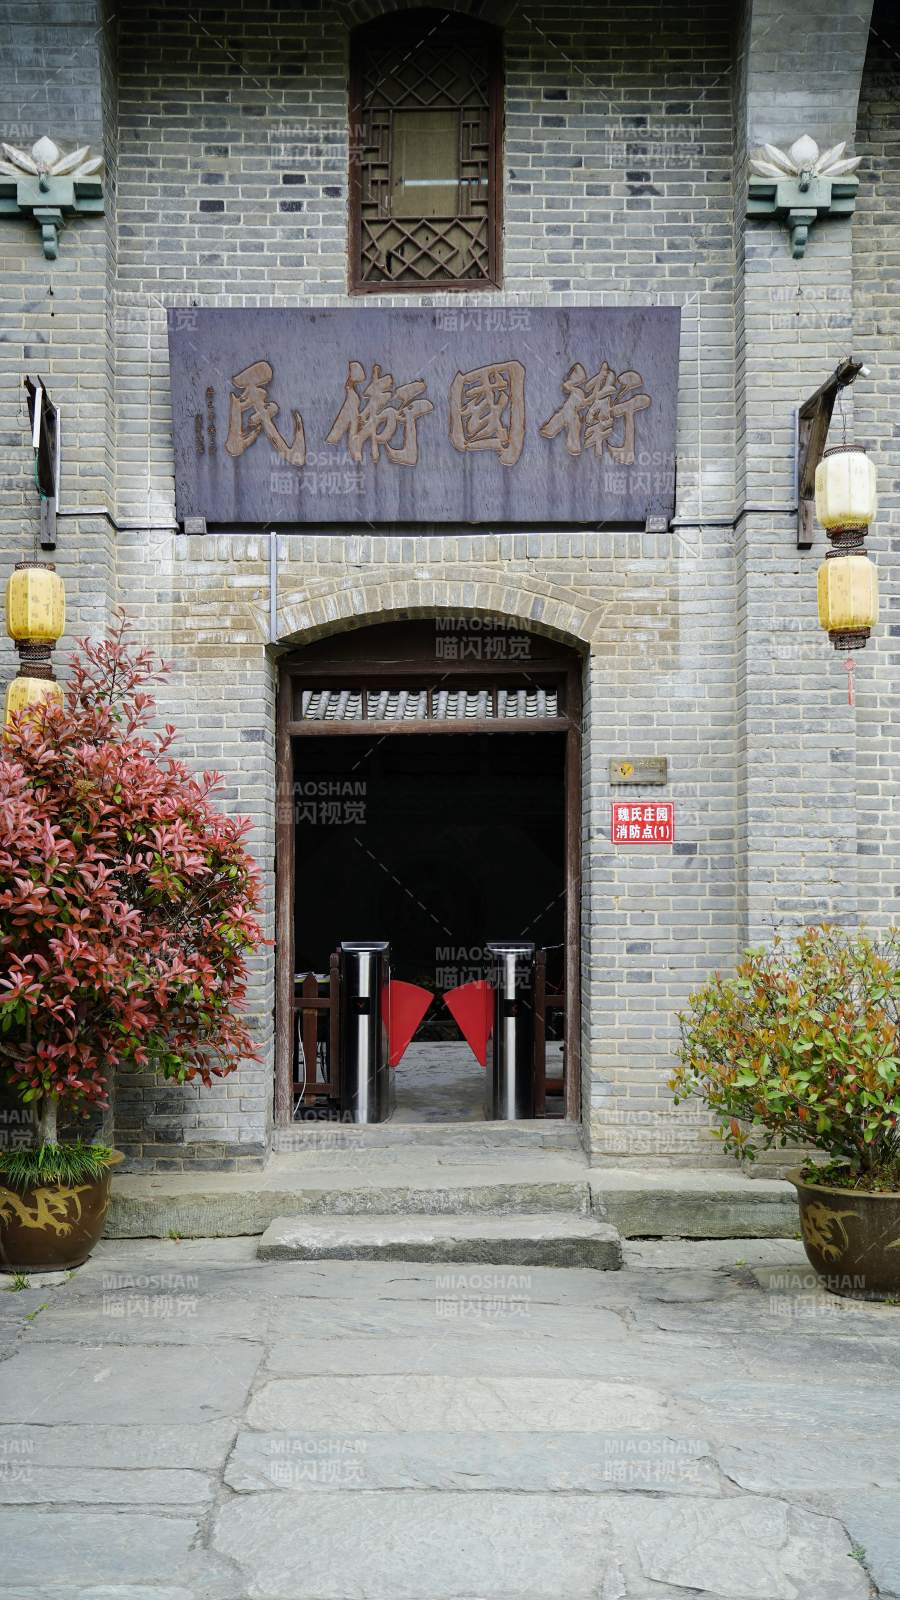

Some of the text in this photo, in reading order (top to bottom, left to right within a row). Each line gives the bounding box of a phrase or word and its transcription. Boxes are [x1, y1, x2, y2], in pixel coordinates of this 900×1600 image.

[617, 807, 668, 821] 魏氏庄园
[616, 824, 670, 839] 消防点(1)
